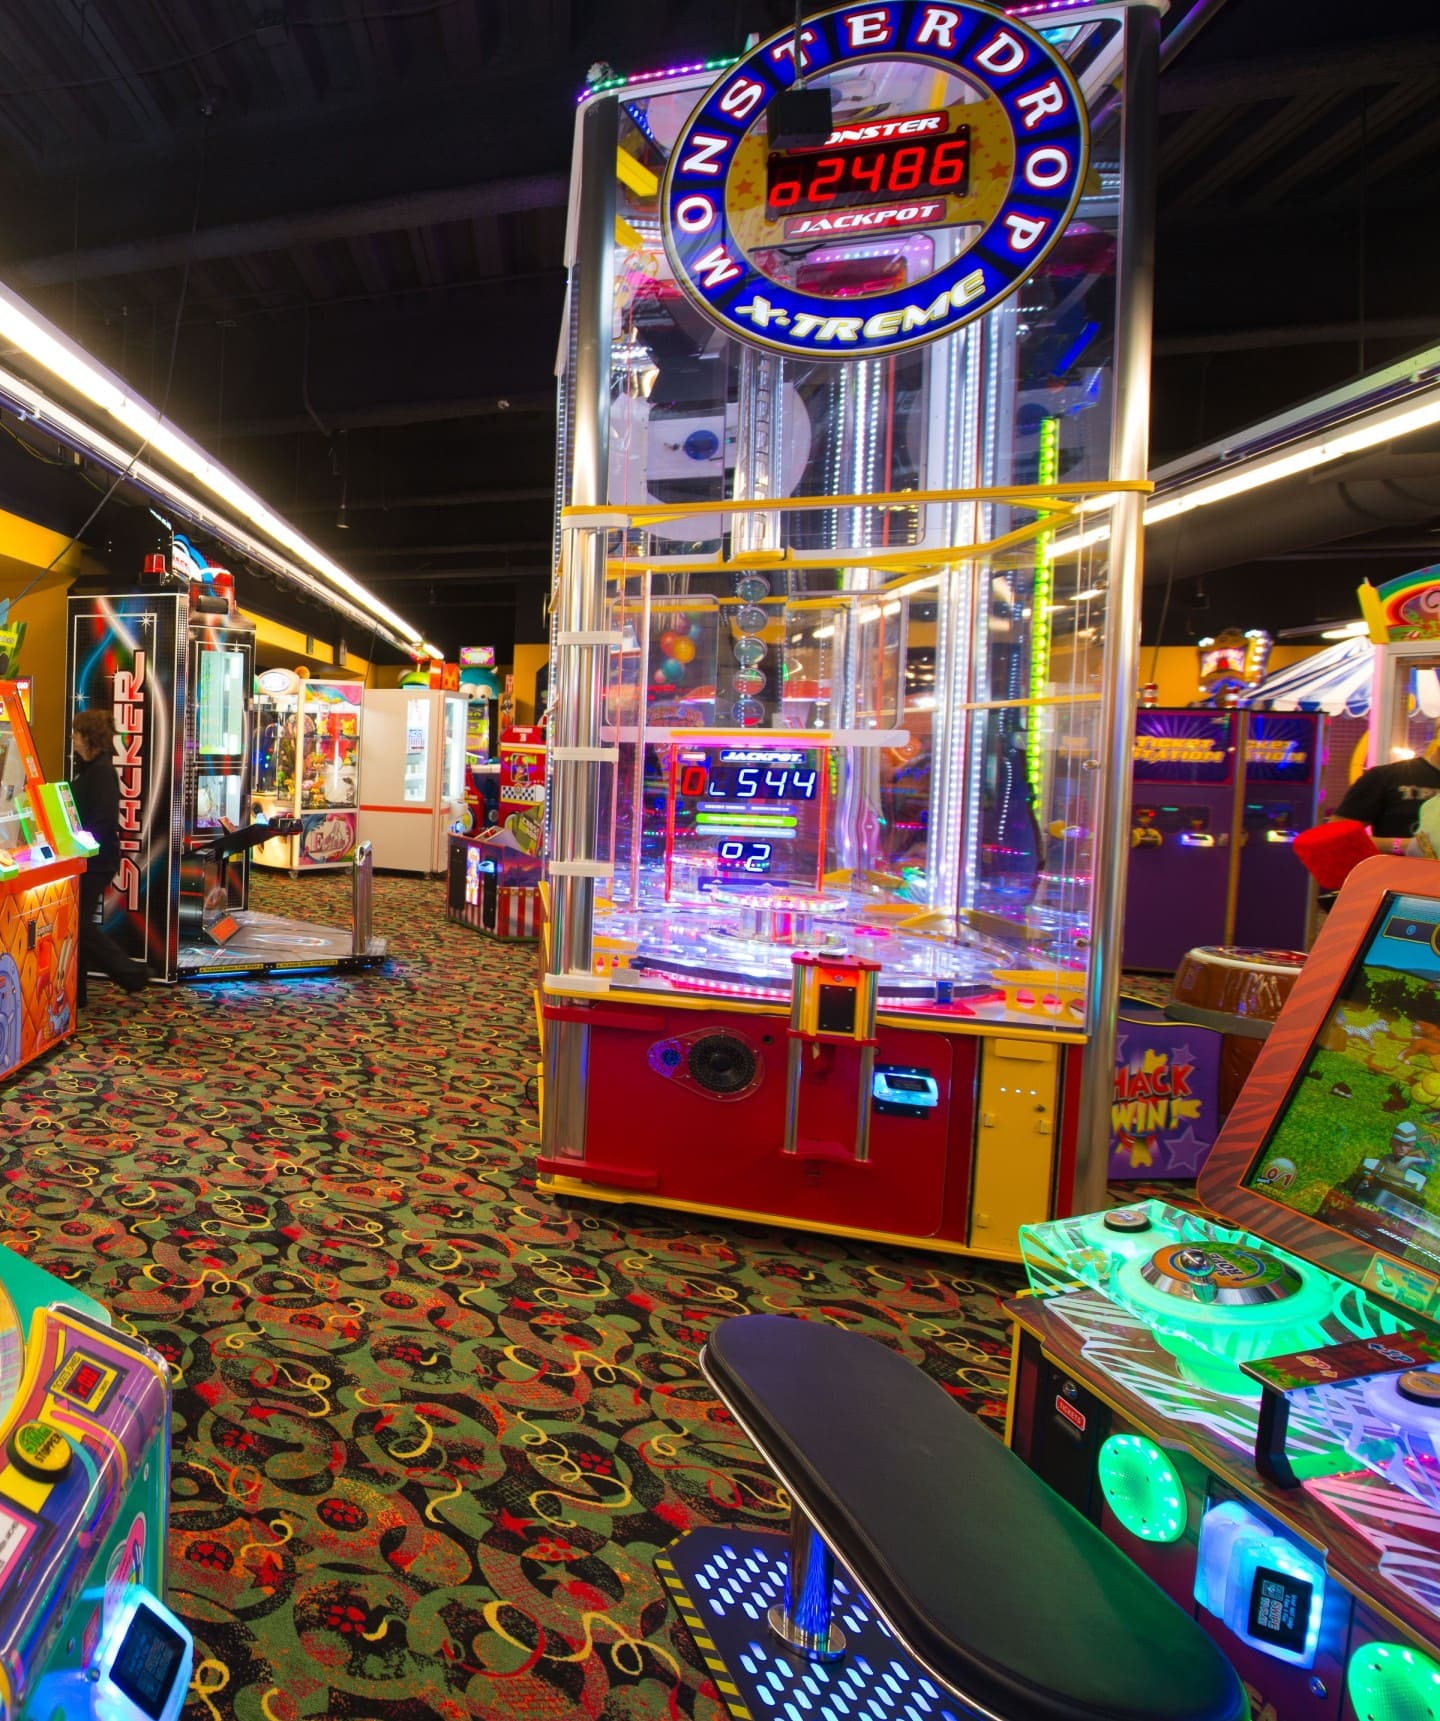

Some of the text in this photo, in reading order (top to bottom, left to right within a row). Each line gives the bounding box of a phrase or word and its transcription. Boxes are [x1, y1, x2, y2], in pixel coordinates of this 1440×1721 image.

[823, 117, 941, 146] ONSTER
[790, 204, 940, 234] JACKPOT
[735, 268, 987, 342] X-TREME
[722, 751, 803, 763] JACKPOT
[1132, 748, 1226, 764] STATION
[1136, 736, 1216, 751] TICKET
[112, 649, 147, 912] STACKER
[1114, 1063, 1195, 1101] HACK
[33, 1429, 63, 1464] STOPPER
